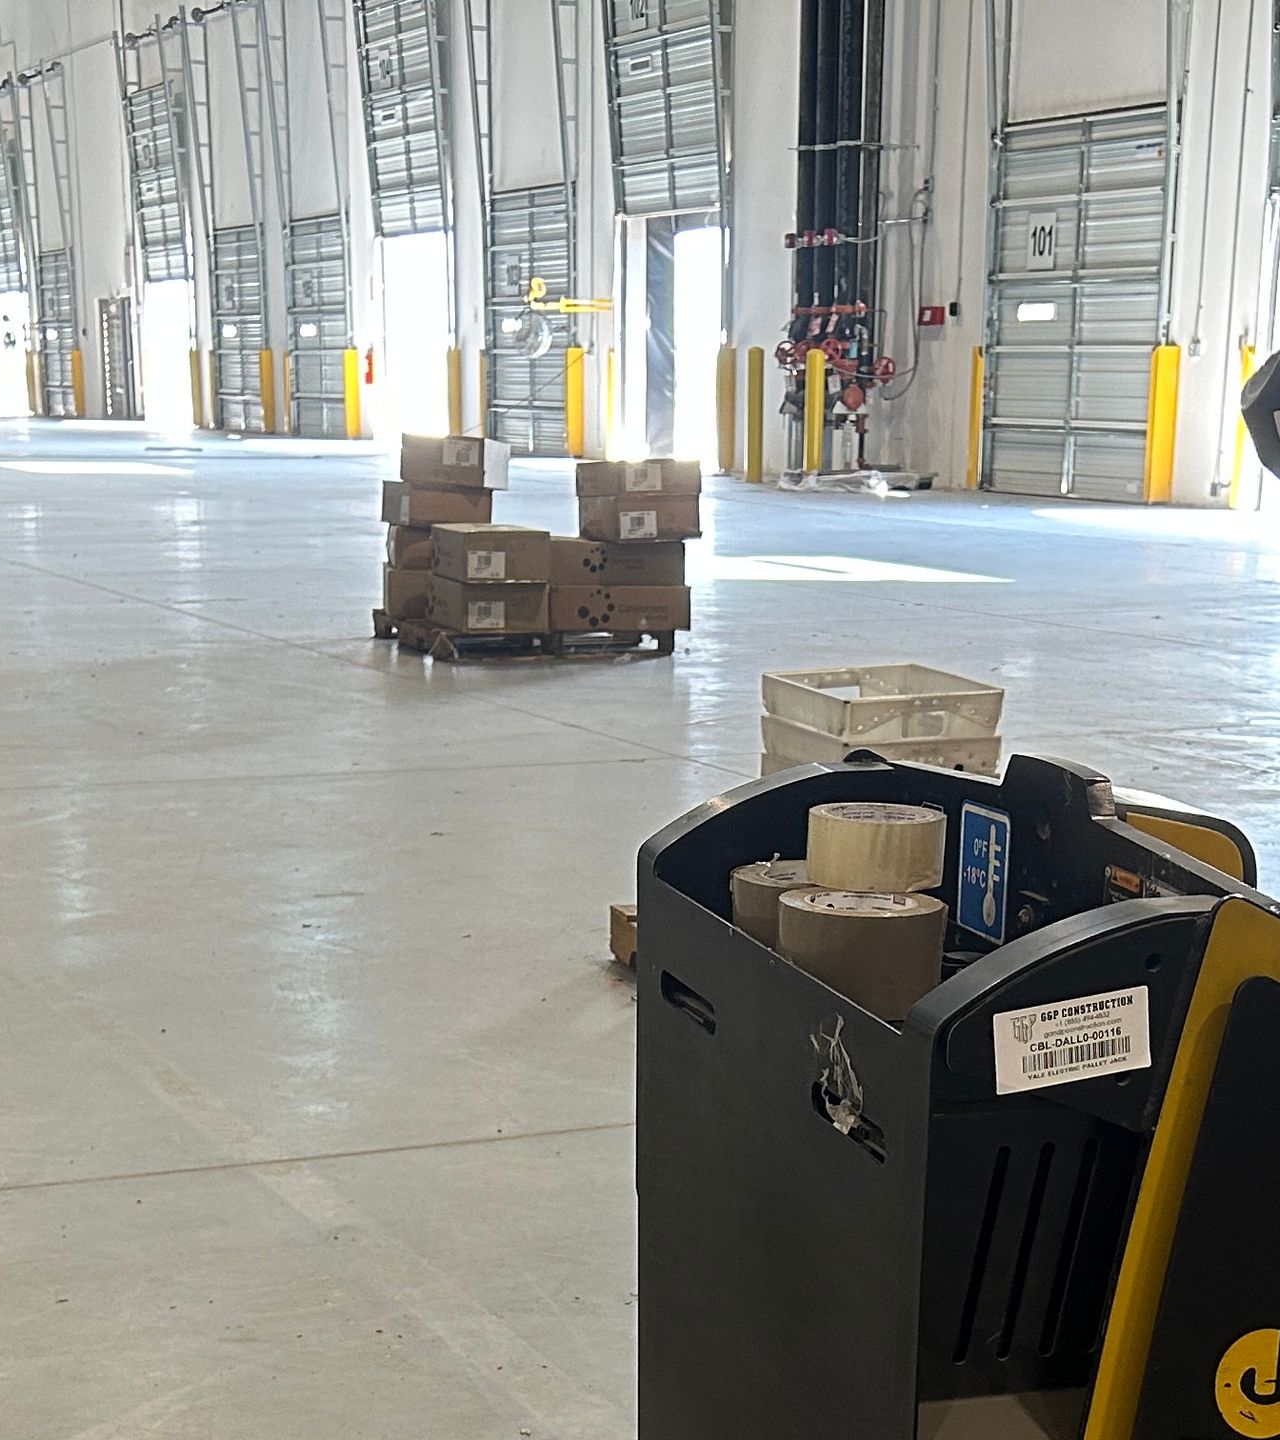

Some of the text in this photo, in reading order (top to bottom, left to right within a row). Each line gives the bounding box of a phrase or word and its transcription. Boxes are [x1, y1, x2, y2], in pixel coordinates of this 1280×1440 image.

[1031, 225, 1053, 257] 101
[1061, 995, 1134, 1018] CONSTRUCTION
[1048, 1065, 1080, 1077] ELECTRIC
[1082, 1059, 1108, 1070] PALLET
[1109, 1055, 1128, 1065] JACK
